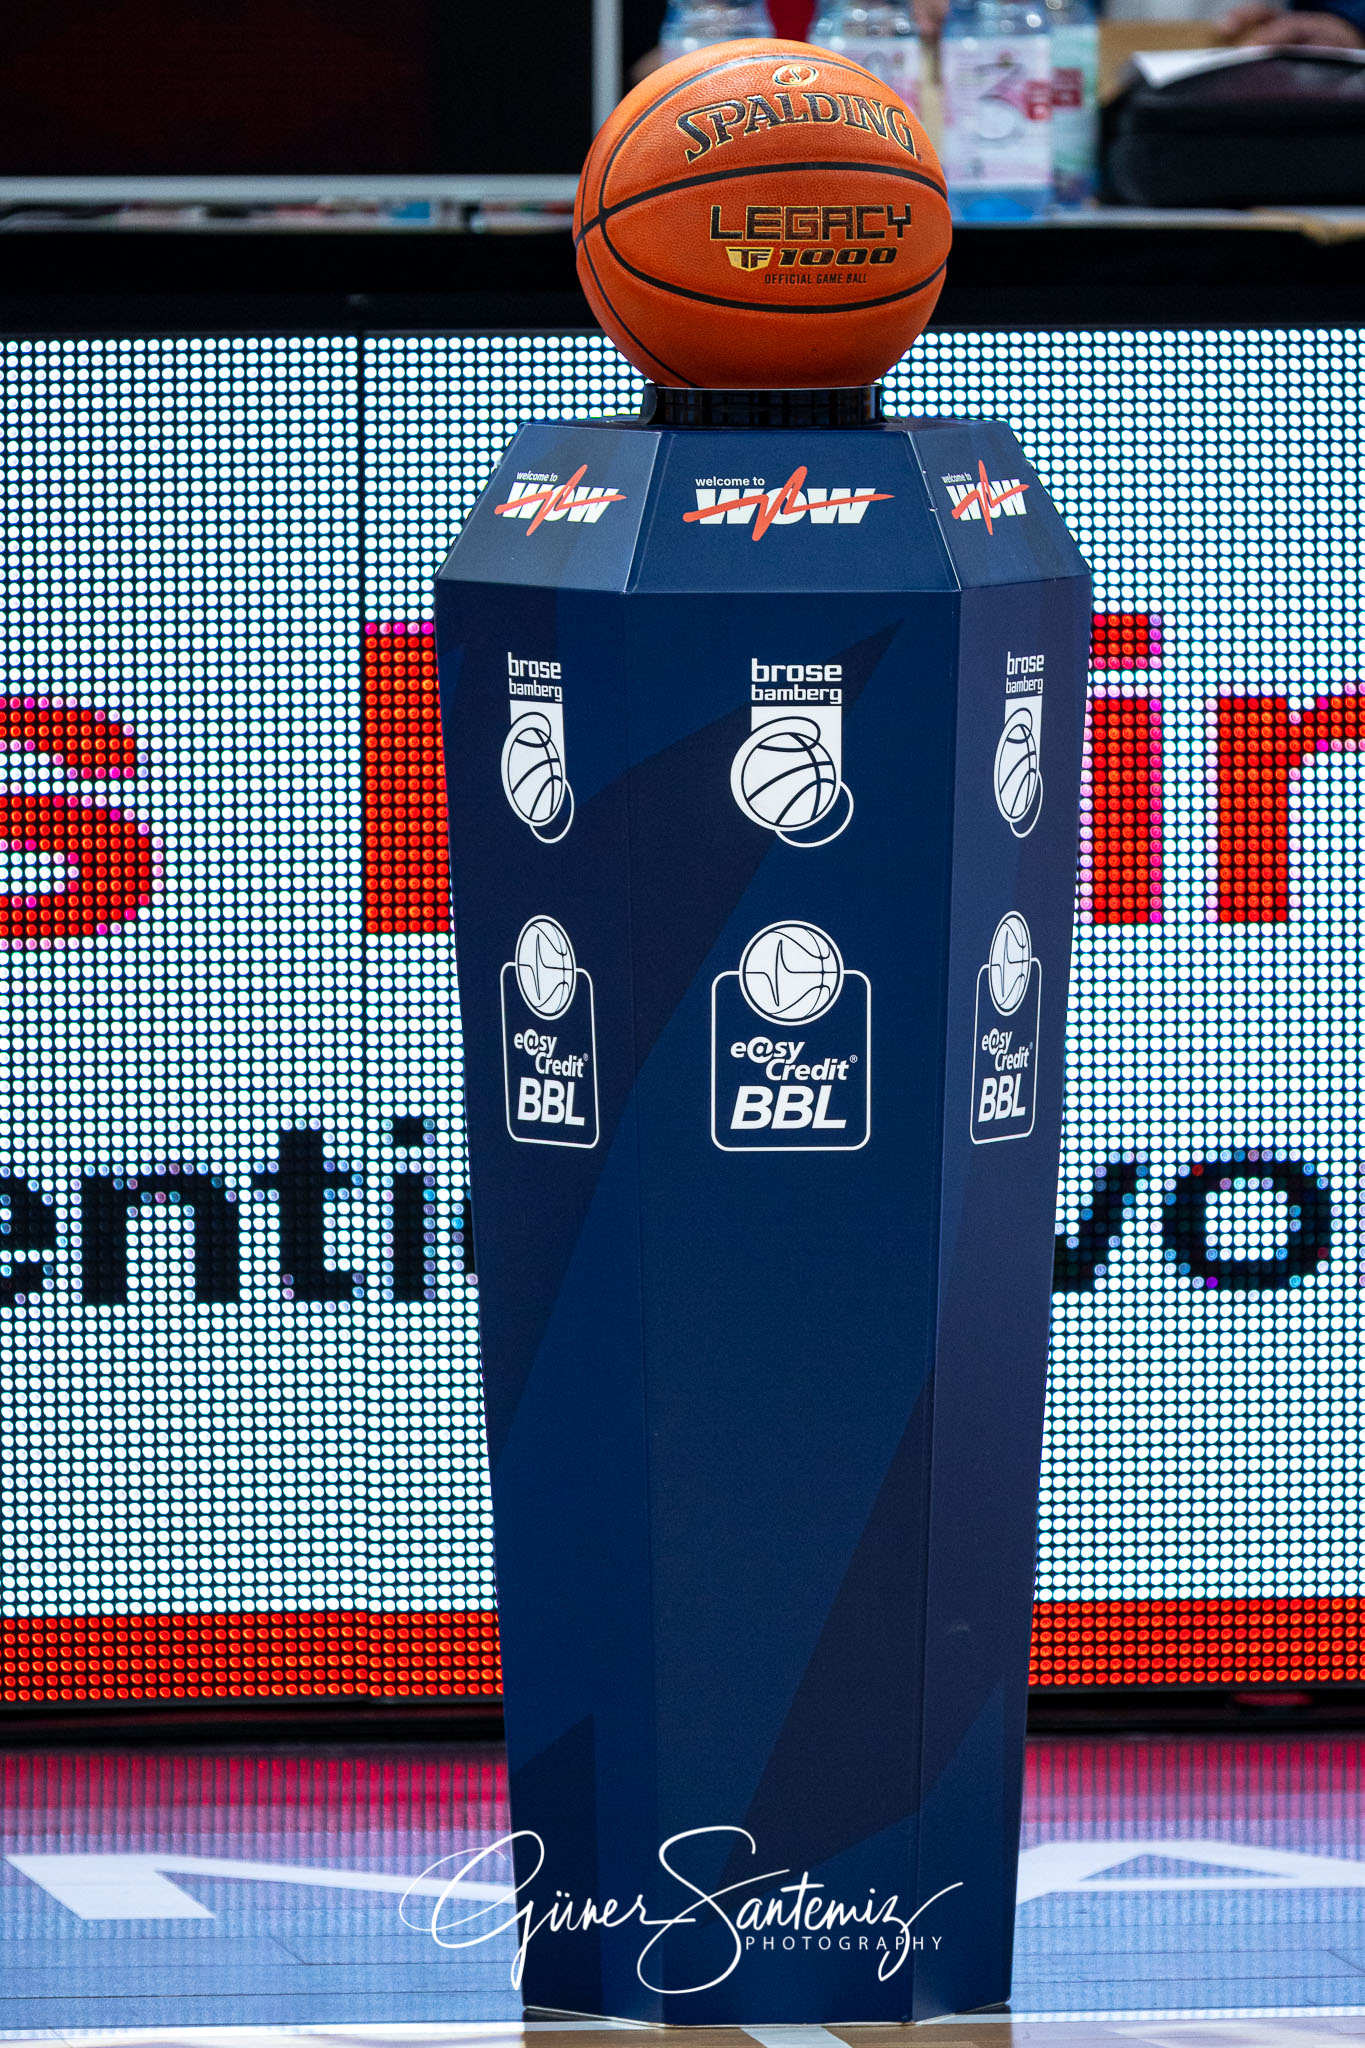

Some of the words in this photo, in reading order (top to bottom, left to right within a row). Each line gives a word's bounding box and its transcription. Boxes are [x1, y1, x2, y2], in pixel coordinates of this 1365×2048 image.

[675, 92, 918, 164] SPALDING
[710, 204, 911, 241] LEGACY
[727, 247, 772, 271] TF
[778, 246, 898, 267] 1000
[764, 273, 812, 285] OFFICIAL
[816, 274, 843, 284] GAME
[846, 273, 867, 284] BALL
[516, 470, 548, 481] welcome
[549, 473, 558, 482] to
[695, 476, 750, 487] welcome
[752, 476, 765, 486] to
[502, 482, 619, 523] WOW
[695, 487, 876, 524] WOW
[945, 479, 1027, 521] WOW
[508, 652, 561, 679] brose
[751, 658, 842, 682] brose
[1007, 651, 1044, 675] brose
[509, 678, 562, 702] bamberg
[751, 684, 842, 704] bamberg
[1006, 676, 1043, 694] bamberg
[514, 1029, 557, 1058] e@sy
[730, 1036, 805, 1064] e@sy
[517, 1077, 585, 1126] BBL
[730, 1085, 847, 1129] BBL
[978, 1073, 1026, 1122] BBL
